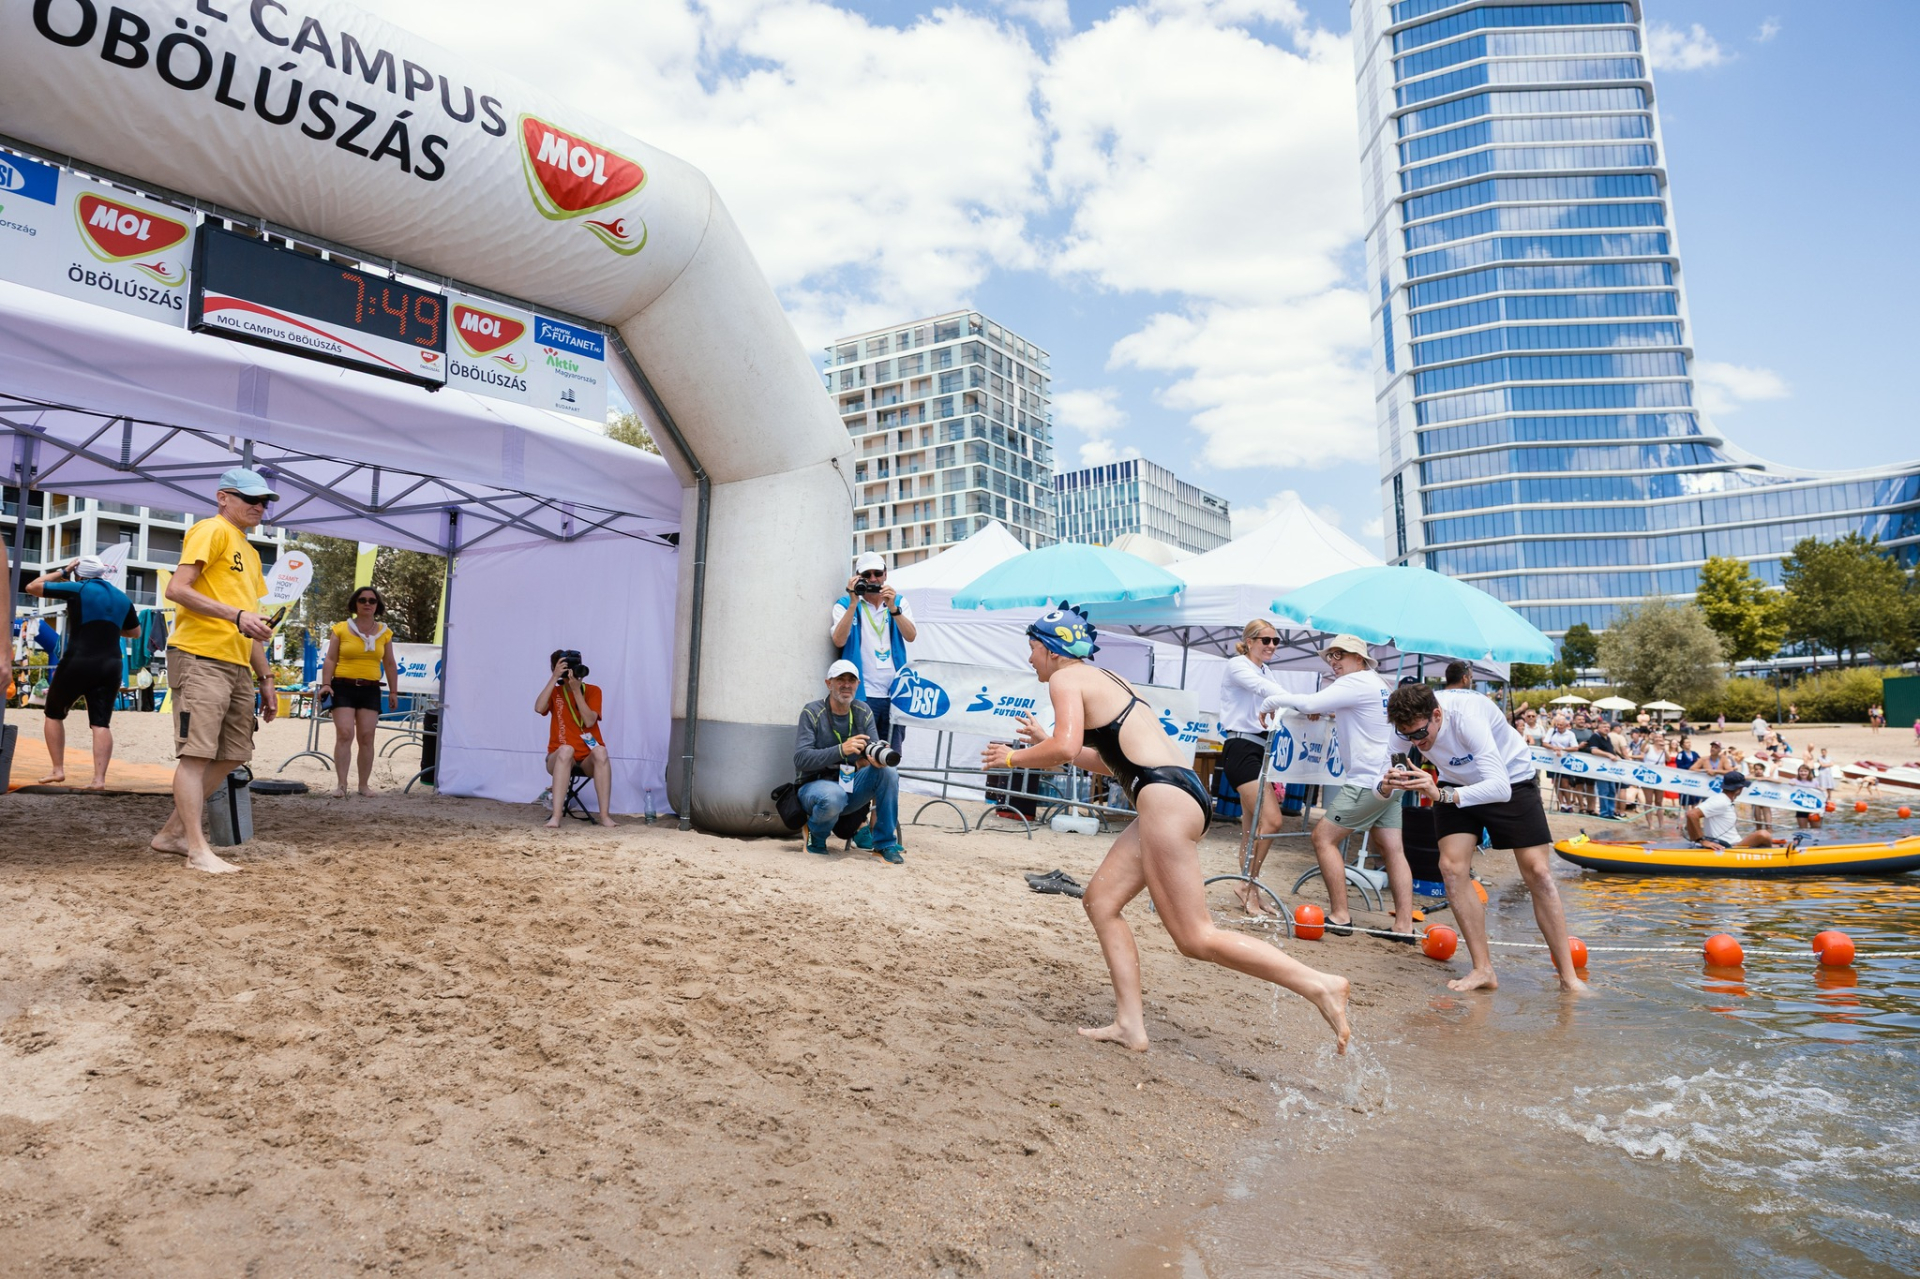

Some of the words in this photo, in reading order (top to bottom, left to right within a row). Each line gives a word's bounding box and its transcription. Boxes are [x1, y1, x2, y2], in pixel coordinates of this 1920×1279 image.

[250, 0, 507, 137] CAMPUS
[537, 131, 608, 186] MOL
[89, 204, 151, 241] MOL
[68, 262, 183, 310] ÖBÖLÚSZÁS
[342, 272, 440, 347] 7:49
[461, 312, 502, 338] MOL
[217, 314, 241, 328] MOL
[243, 321, 286, 339] CAMPUS
[288, 326, 342, 353] ÖBÖLÚSZÁS
[450, 360, 527, 392] ÖBÖLÚSZÁS
[546, 355, 579, 372] Aktiv
[555, 368, 597, 385] Magyarország
[408, 662, 427, 671] SPURI
[909, 686, 940, 716] BSI
[997, 696, 1036, 709] SPURI
